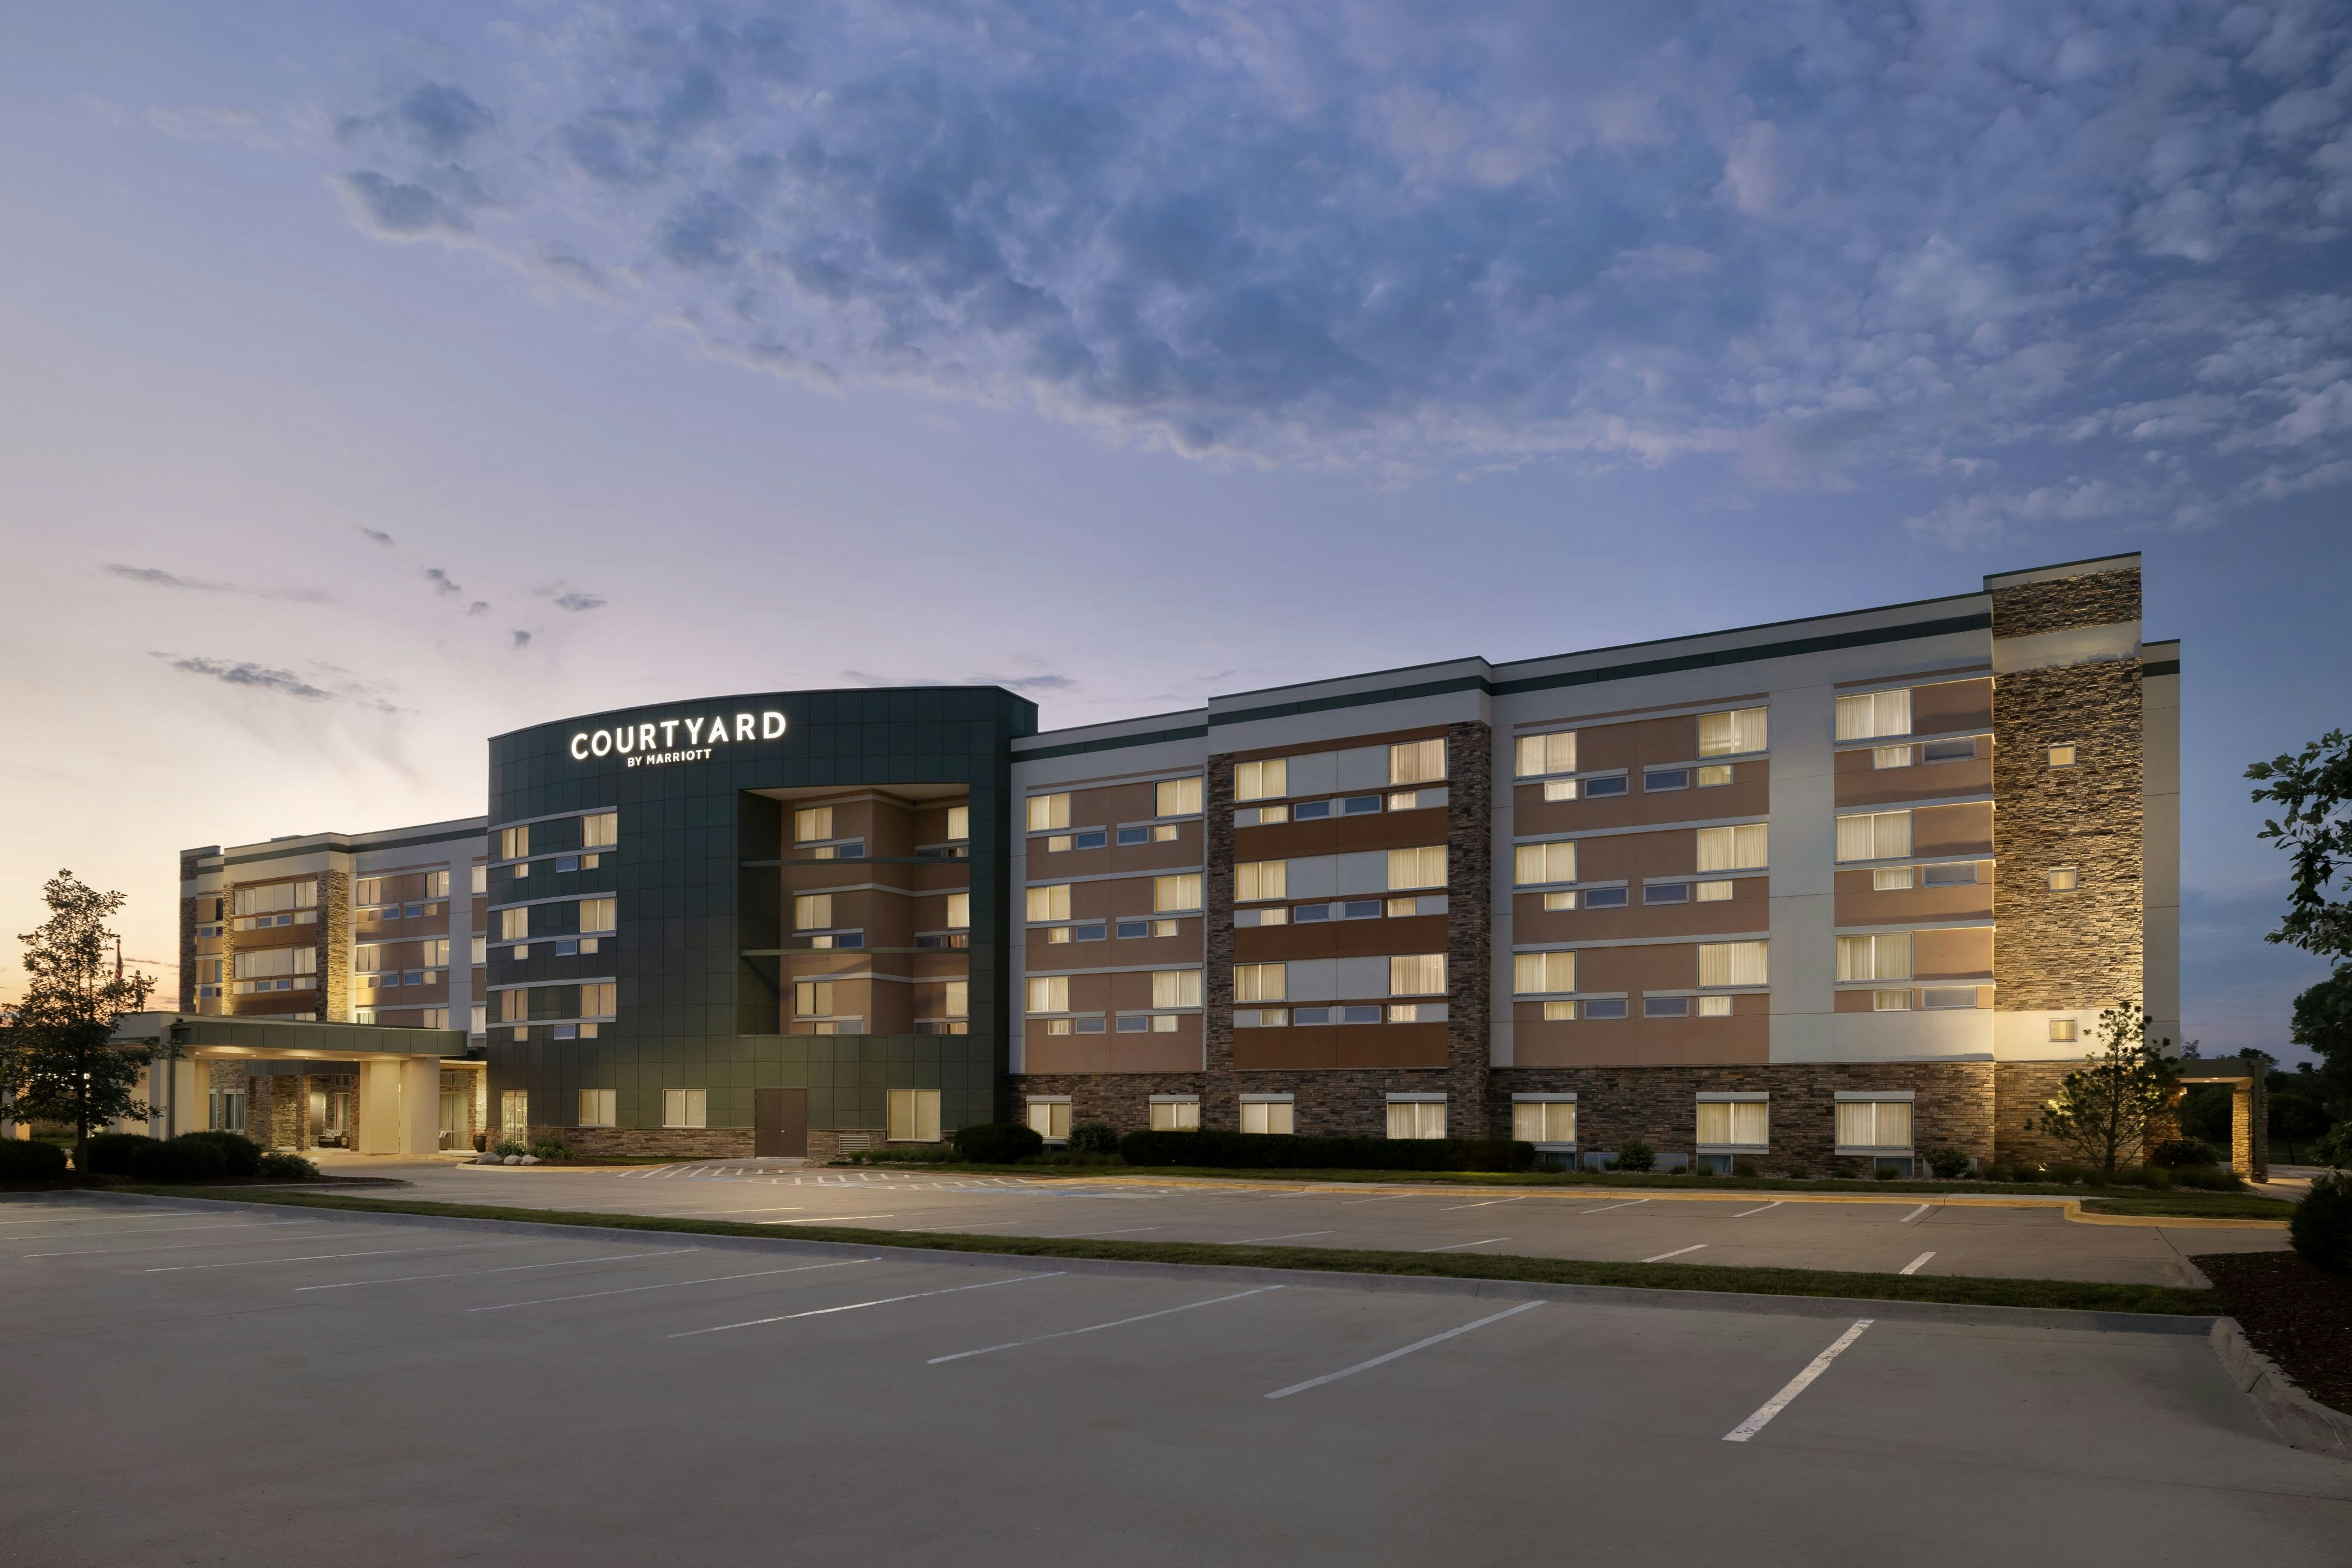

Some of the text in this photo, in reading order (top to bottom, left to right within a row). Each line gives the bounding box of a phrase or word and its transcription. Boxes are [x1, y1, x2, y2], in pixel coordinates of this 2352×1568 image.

[571, 711, 786, 760] COURTYARD
[627, 748, 711, 767] BY MARRIOTT
